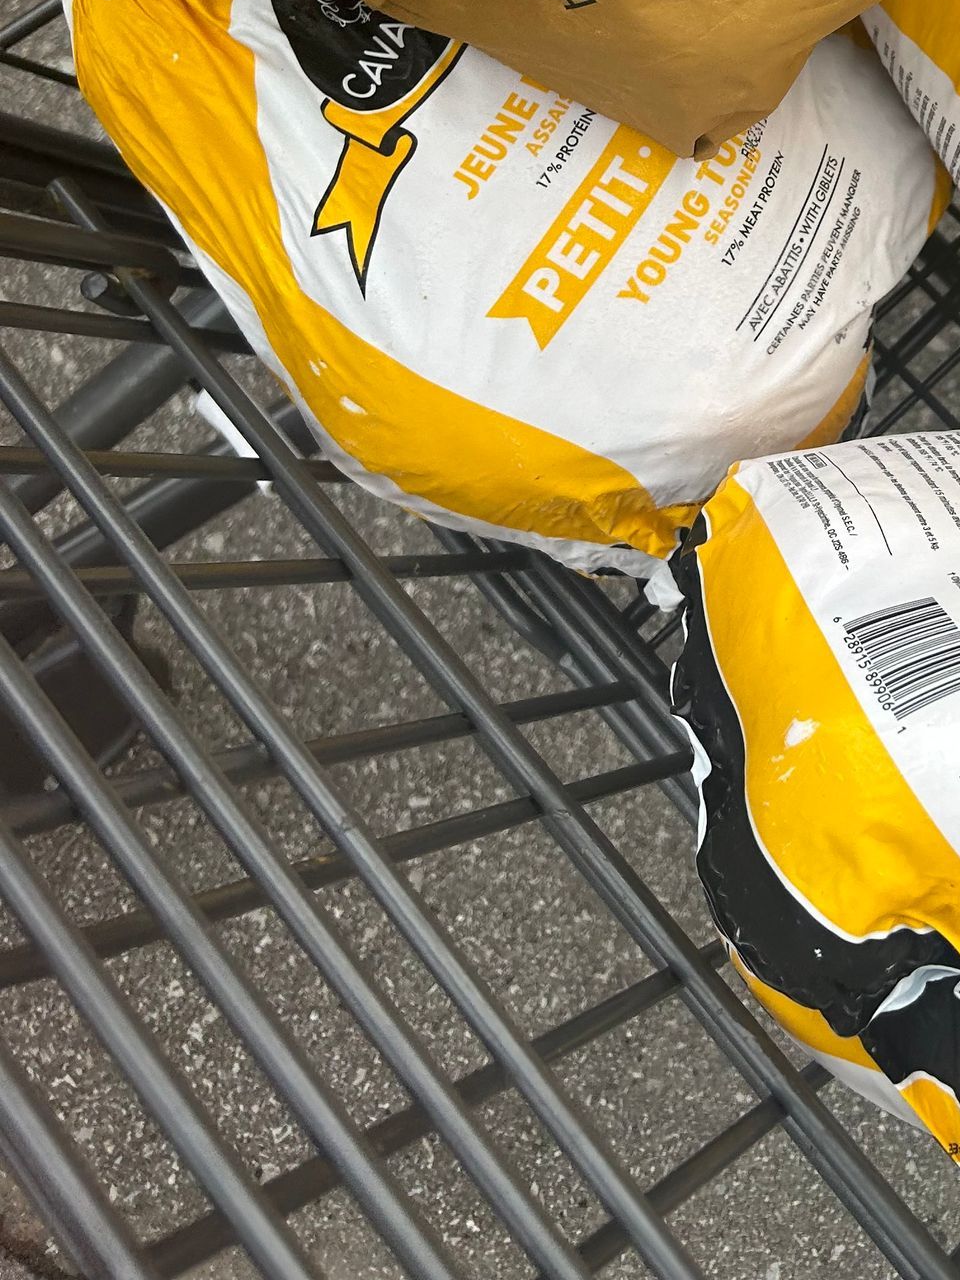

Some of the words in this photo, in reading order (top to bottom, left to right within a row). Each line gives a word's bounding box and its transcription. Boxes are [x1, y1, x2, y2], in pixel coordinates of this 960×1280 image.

[454, 85, 541, 200] JEUNE
[535, 171, 552, 189] 17
[546, 161, 563, 174] %
[705, 143, 761, 244] SEASONED
[522, 156, 648, 312] PETIT
[616, 190, 710, 304] YOUNG
[721, 239, 744, 266] 17%
[739, 201, 763, 238] MEAT
[758, 150, 784, 203] PROTEIN
[749, 294, 774, 332] AVEC
[771, 243, 802, 296] ABATTIS
[799, 202, 821, 234] WITH
[816, 156, 838, 202] GIBLETS
[767, 302, 804, 355] CERTAINES
[801, 263, 825, 302] PARTIES
[821, 218, 844, 263] PEUVENT
[840, 169, 861, 217] MANQUER
[798, 308, 816, 330] MAY
[813, 278, 829, 306] HAVE
[826, 249, 842, 279] PARTS
[840, 206, 861, 250] MISSING
[832, 616, 843, 624] 6
[843, 631, 871, 669] 28915
[865, 672, 895, 711] 89906
[896, 725, 908, 735] 1
